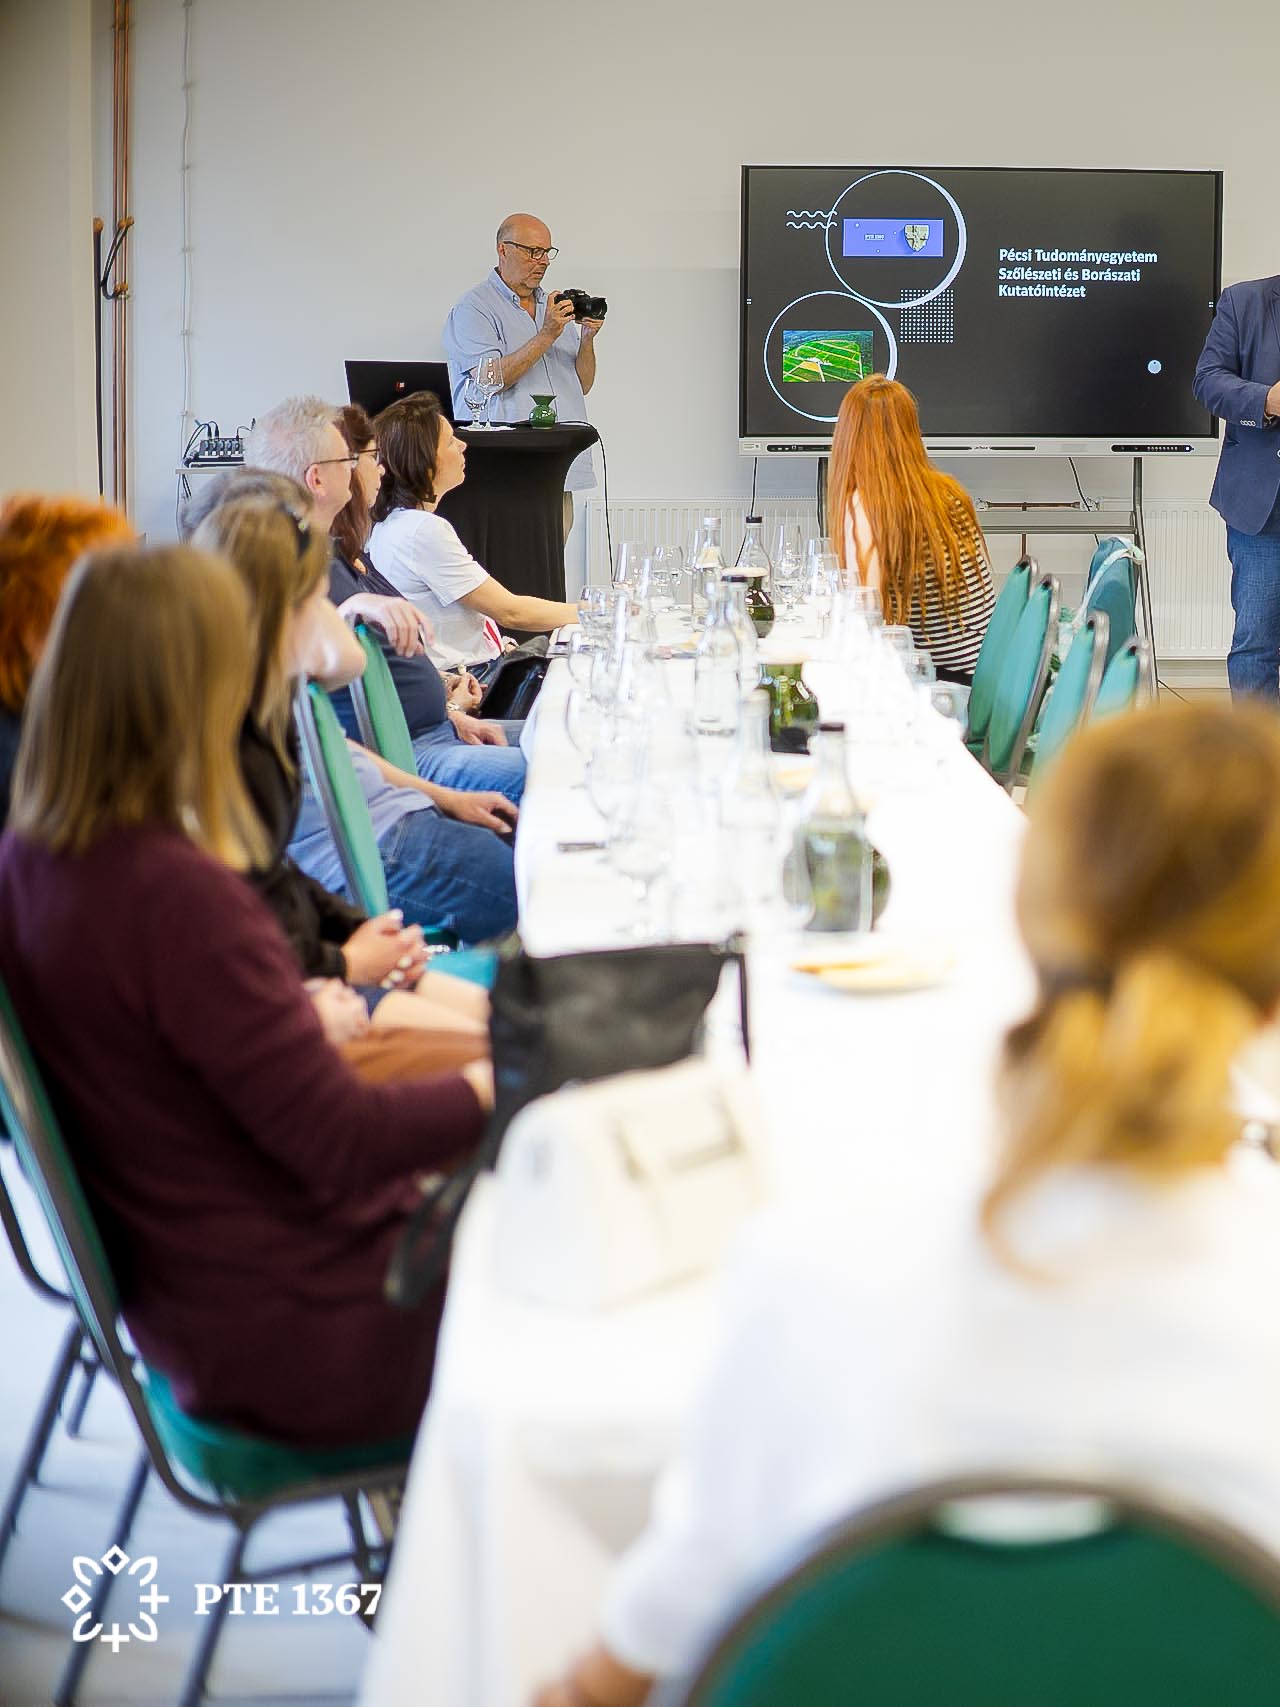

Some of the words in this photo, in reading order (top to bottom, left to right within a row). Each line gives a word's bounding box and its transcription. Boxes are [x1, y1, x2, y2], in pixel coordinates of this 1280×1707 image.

[999, 248, 1032, 262] Pécsi
[1034, 249, 1158, 265] Tudományegyetem
[998, 267, 1062, 281] Szőlészeti
[1064, 268, 1079, 281] és
[1081, 268, 1141, 282] Borászati
[998, 284, 1087, 298] Kutatóintézet
